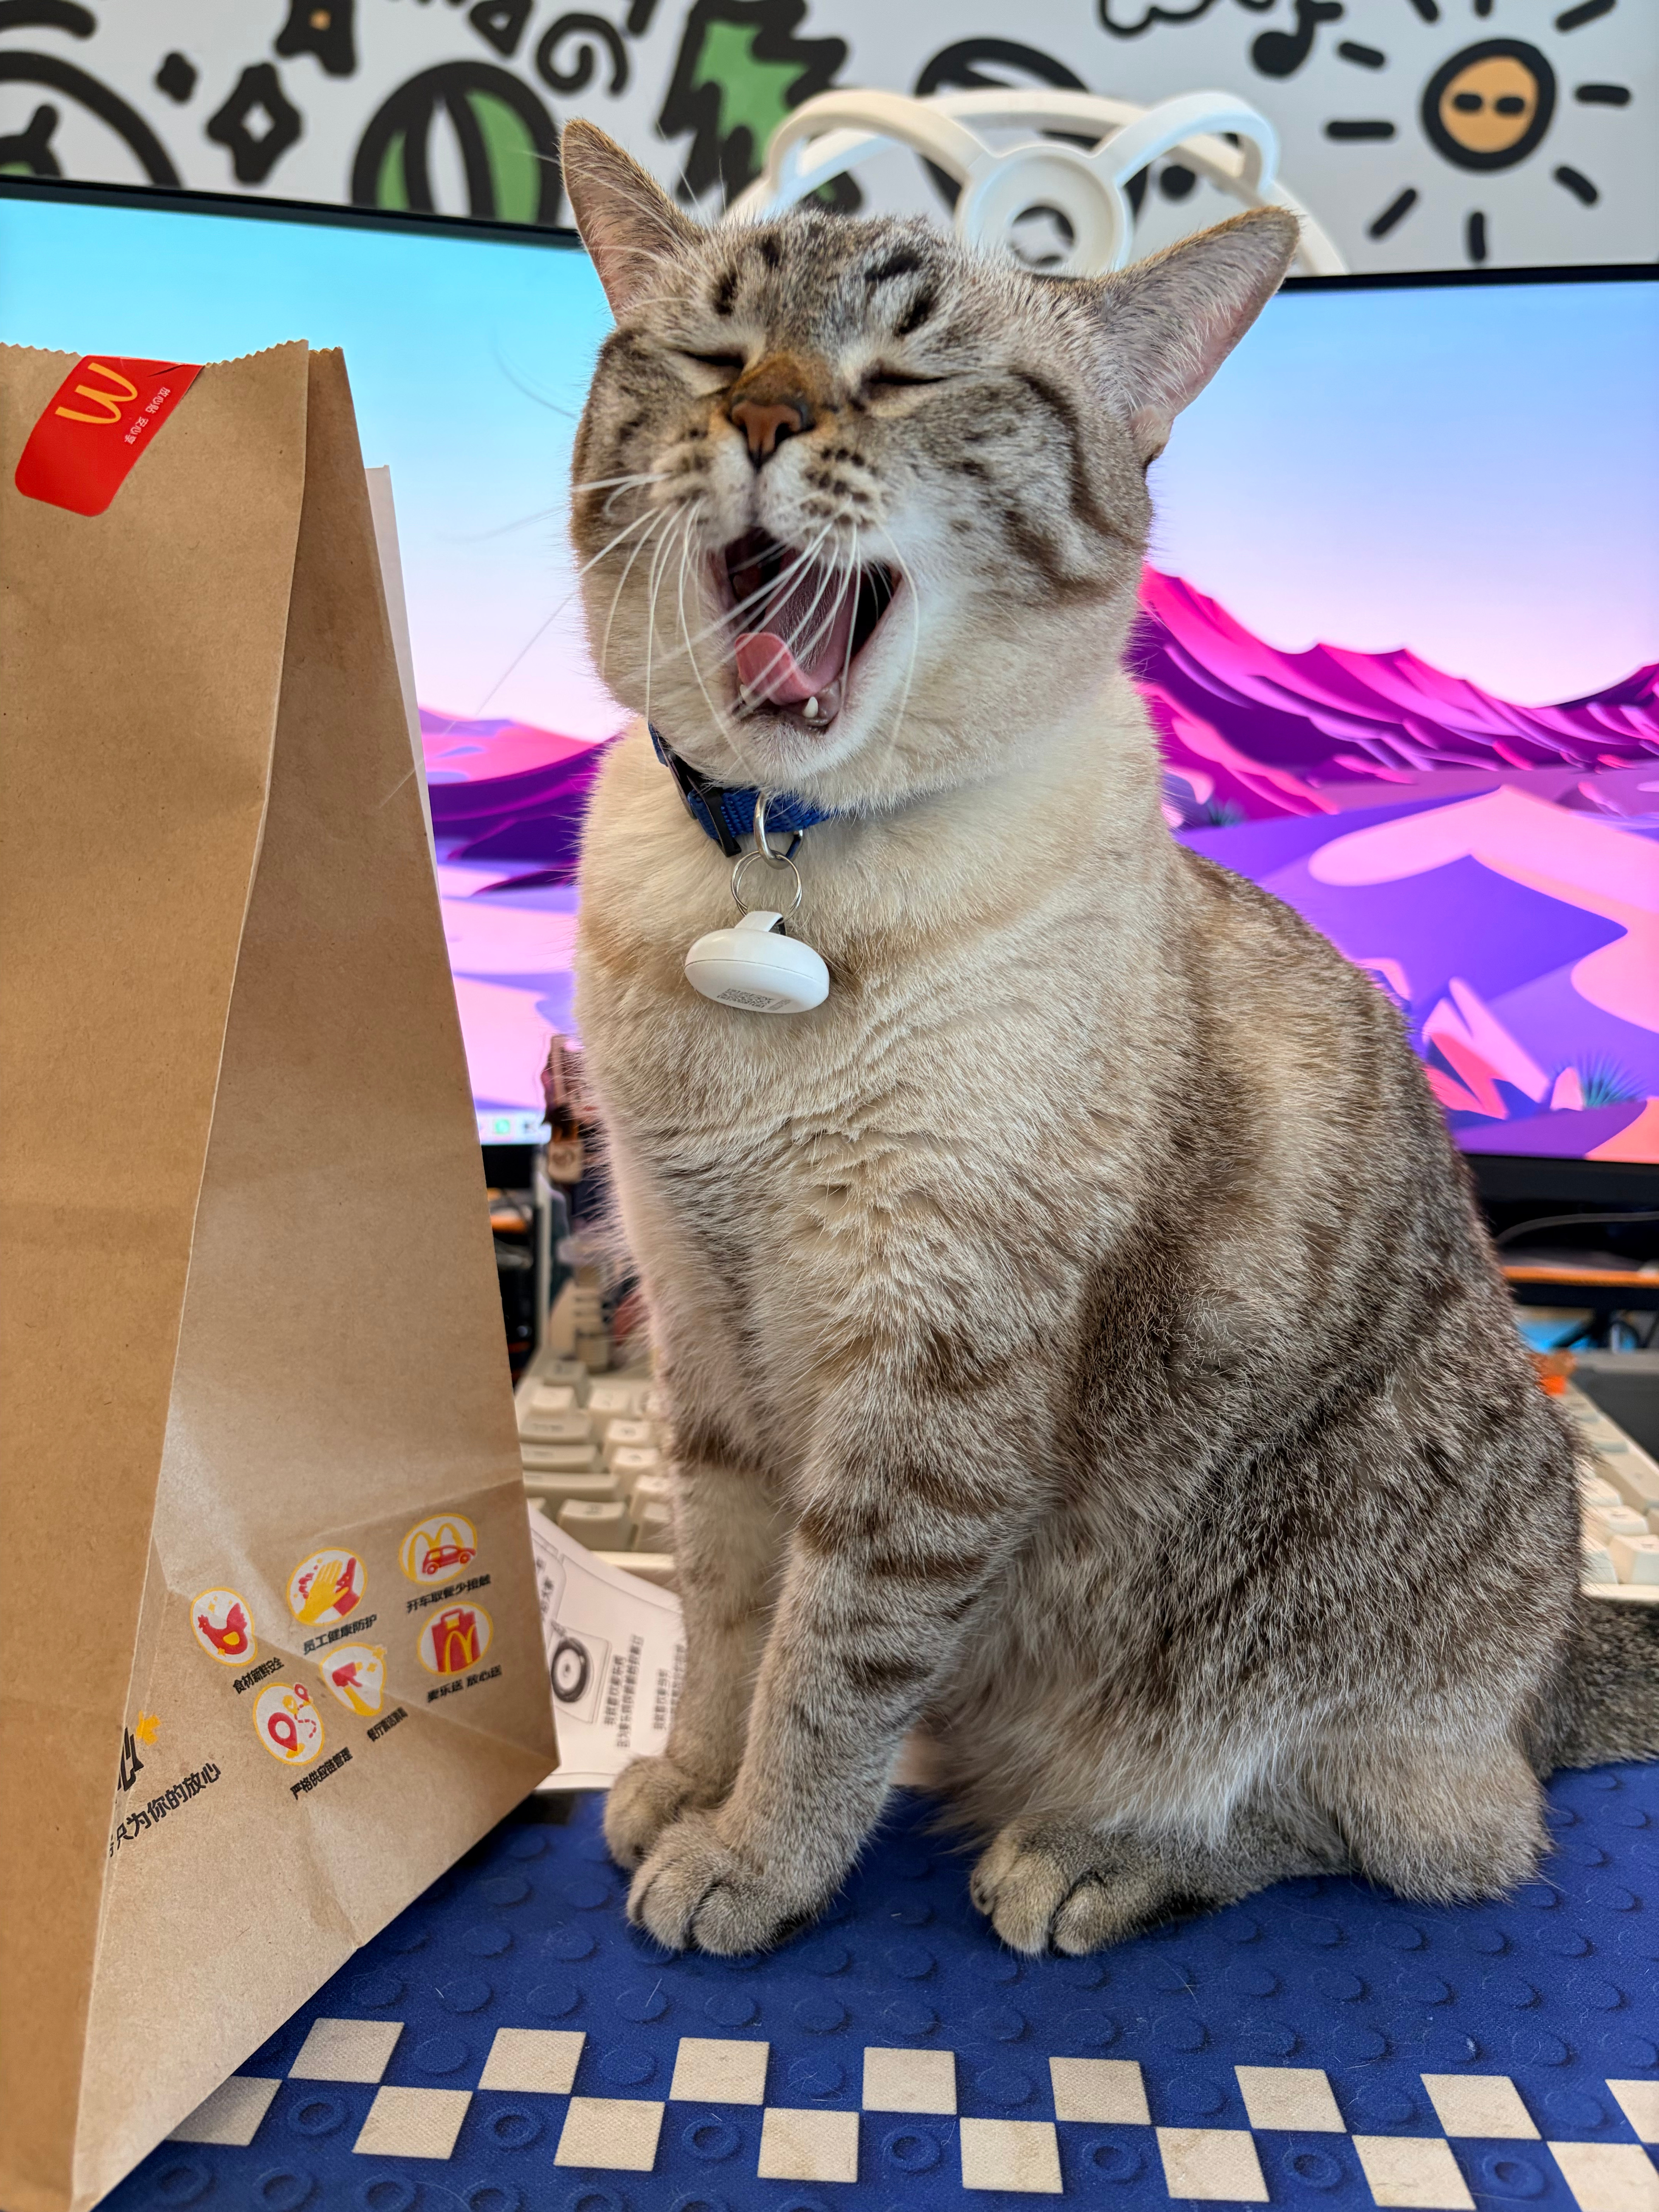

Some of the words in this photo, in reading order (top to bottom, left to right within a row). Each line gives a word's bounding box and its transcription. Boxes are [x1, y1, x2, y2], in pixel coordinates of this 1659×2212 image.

[145, 386, 171, 414] 放心贴
[124, 416, 149, 445] 安心享
[304, 1614, 378, 1656] 员工健康防护
[232, 1657, 285, 1694] 食材新鲜安全
[427, 1678, 464, 1703] 麦乐送
[466, 1664, 503, 1688] 放心送
[289, 1747, 354, 1801] 严格供应链管理
